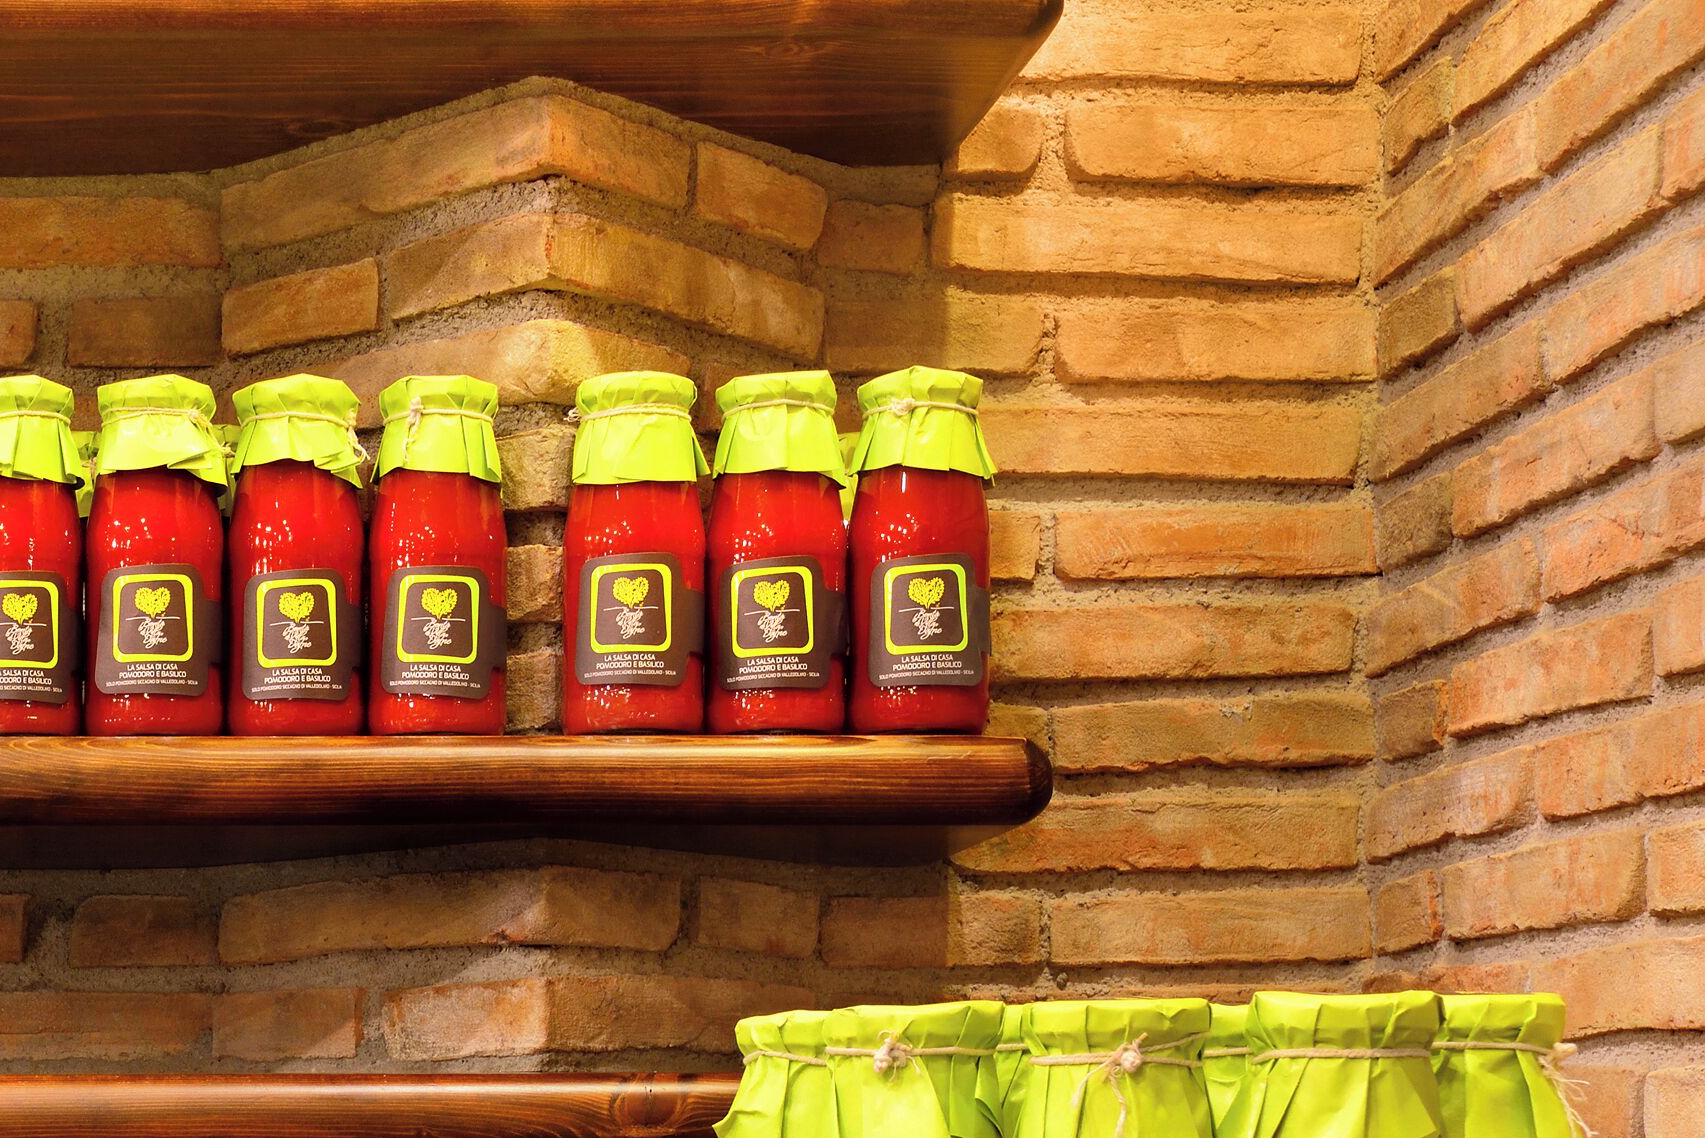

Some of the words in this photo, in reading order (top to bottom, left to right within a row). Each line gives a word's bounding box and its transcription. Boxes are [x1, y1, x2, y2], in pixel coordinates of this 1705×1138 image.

[756, 657, 775, 665] SALSA
[419, 664, 438, 672] SALSA
[445, 665, 462, 673] CASA
[739, 664, 776, 675] POMODORO
[119, 671, 155, 679] POMODORO
[444, 672, 470, 680] BASILICO
